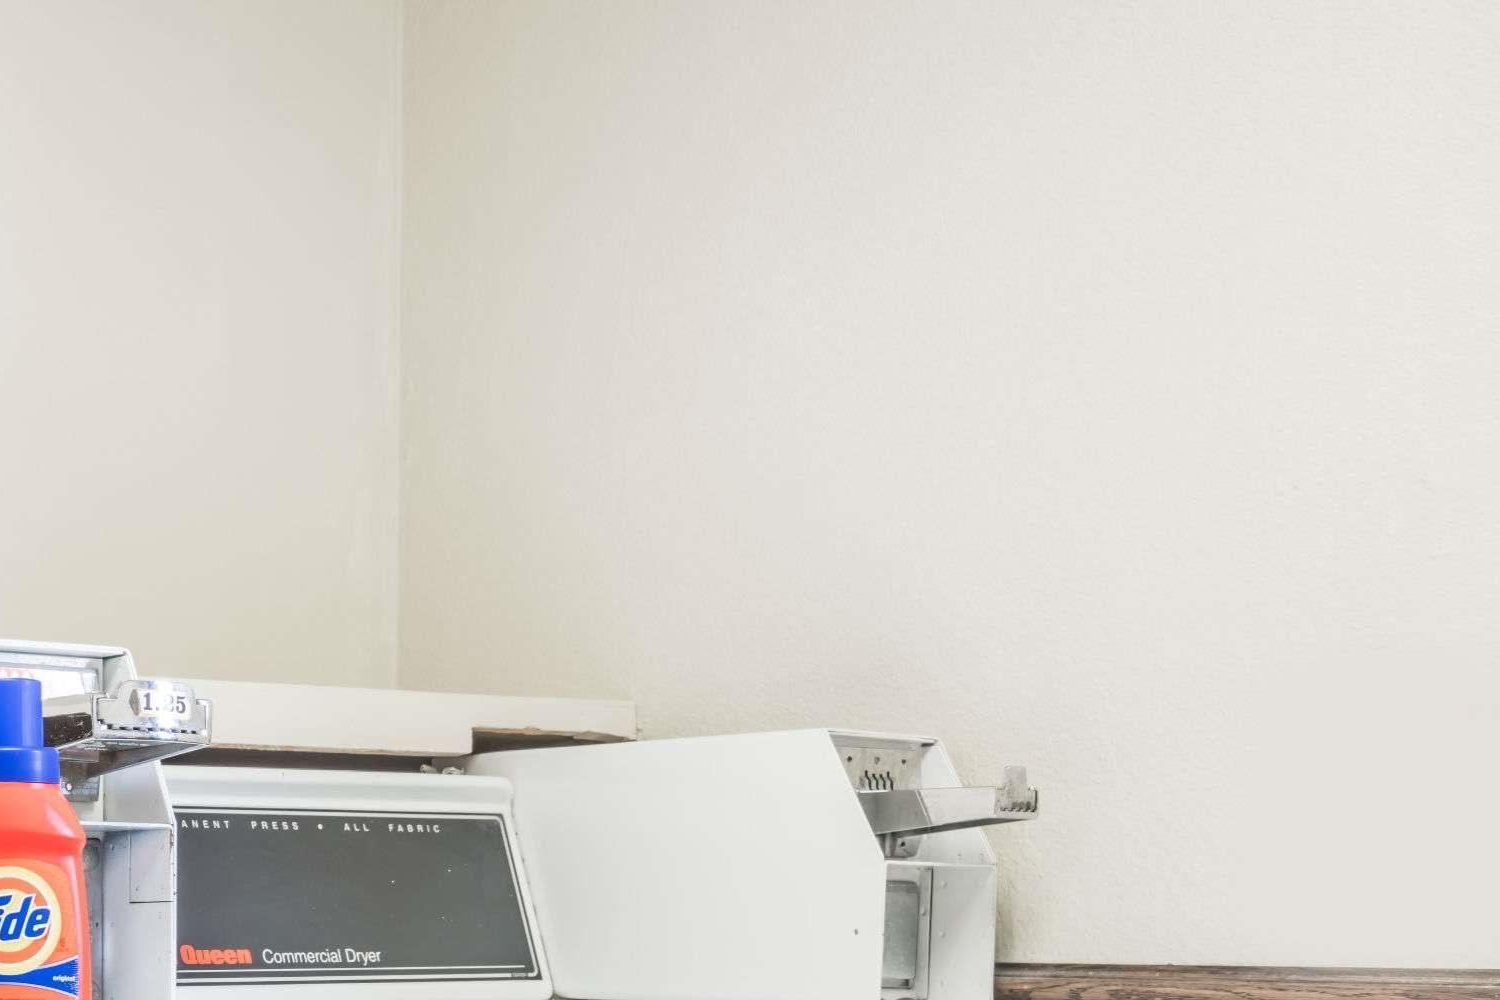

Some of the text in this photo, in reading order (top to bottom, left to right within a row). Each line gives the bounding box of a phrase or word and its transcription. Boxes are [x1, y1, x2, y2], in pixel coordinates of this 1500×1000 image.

[251, 820, 299, 830] PRESS
[343, 822, 370, 832] ALL
[388, 823, 440, 833] FABRIC
[180, 944, 381, 967] Queen Commercial Dryer
